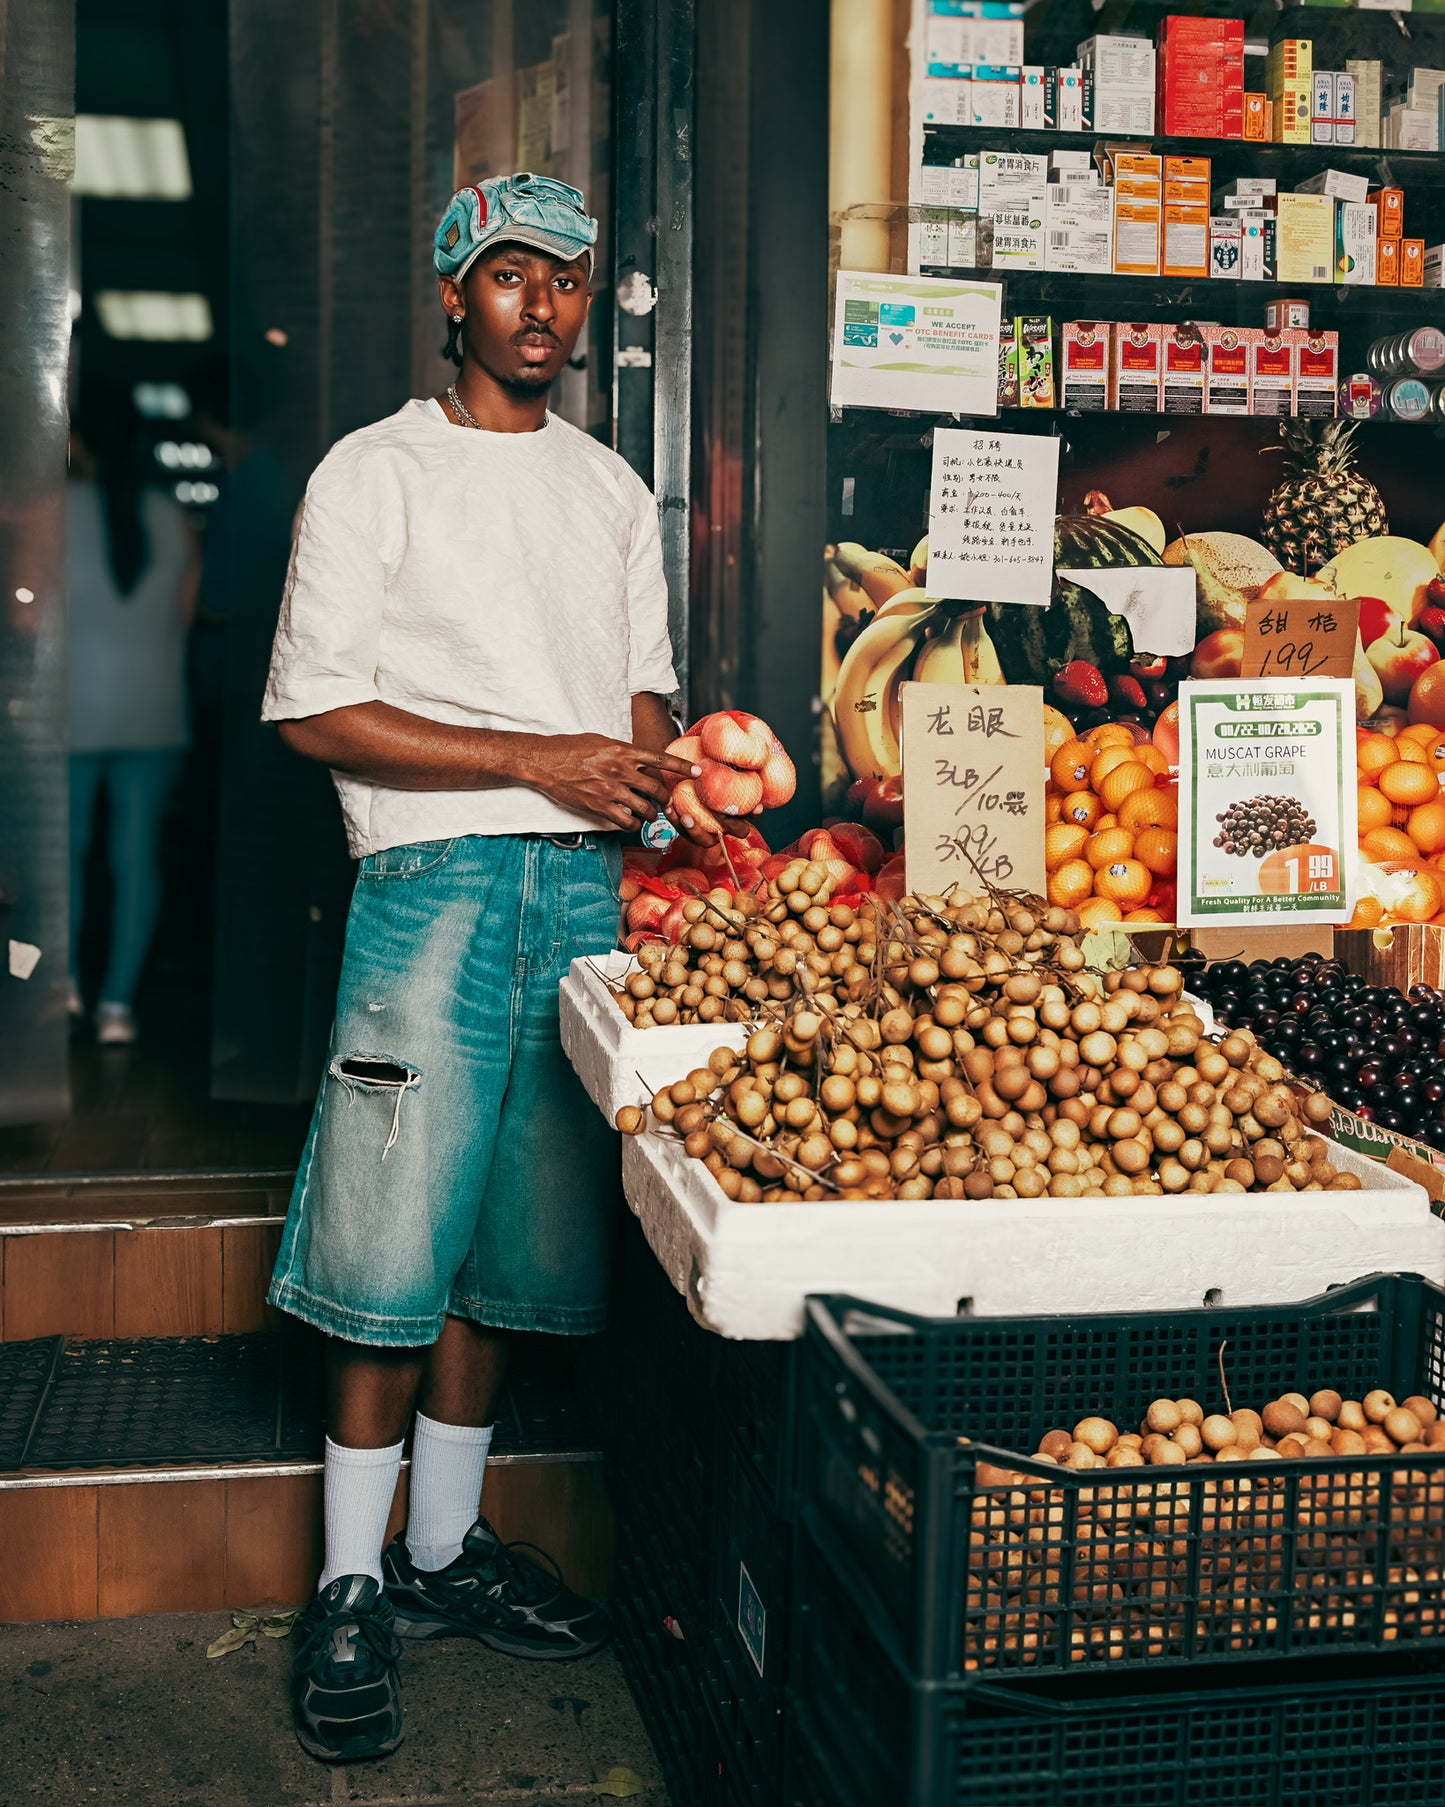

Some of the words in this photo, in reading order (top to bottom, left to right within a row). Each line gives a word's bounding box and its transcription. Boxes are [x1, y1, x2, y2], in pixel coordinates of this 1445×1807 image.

[997, 156, 1040, 173] 健胃消食片
[995, 236, 1037, 250] 健胃消食片
[945, 322, 976, 331] ACCEPT
[914, 328, 931, 336] OTC
[932, 330, 966, 338] BENEFIT
[967, 332, 994, 341] CARDS
[927, 705, 1024, 739] 龙眼
[1206, 746, 1261, 760] MUSCAT
[1264, 745, 1307, 758] GRAPE
[1207, 761, 1295, 778] 意大利葡萄
[1223, 897, 1251, 906] Quality
[1273, 895, 1296, 903] Better
[1297, 894, 1340, 903] Community
